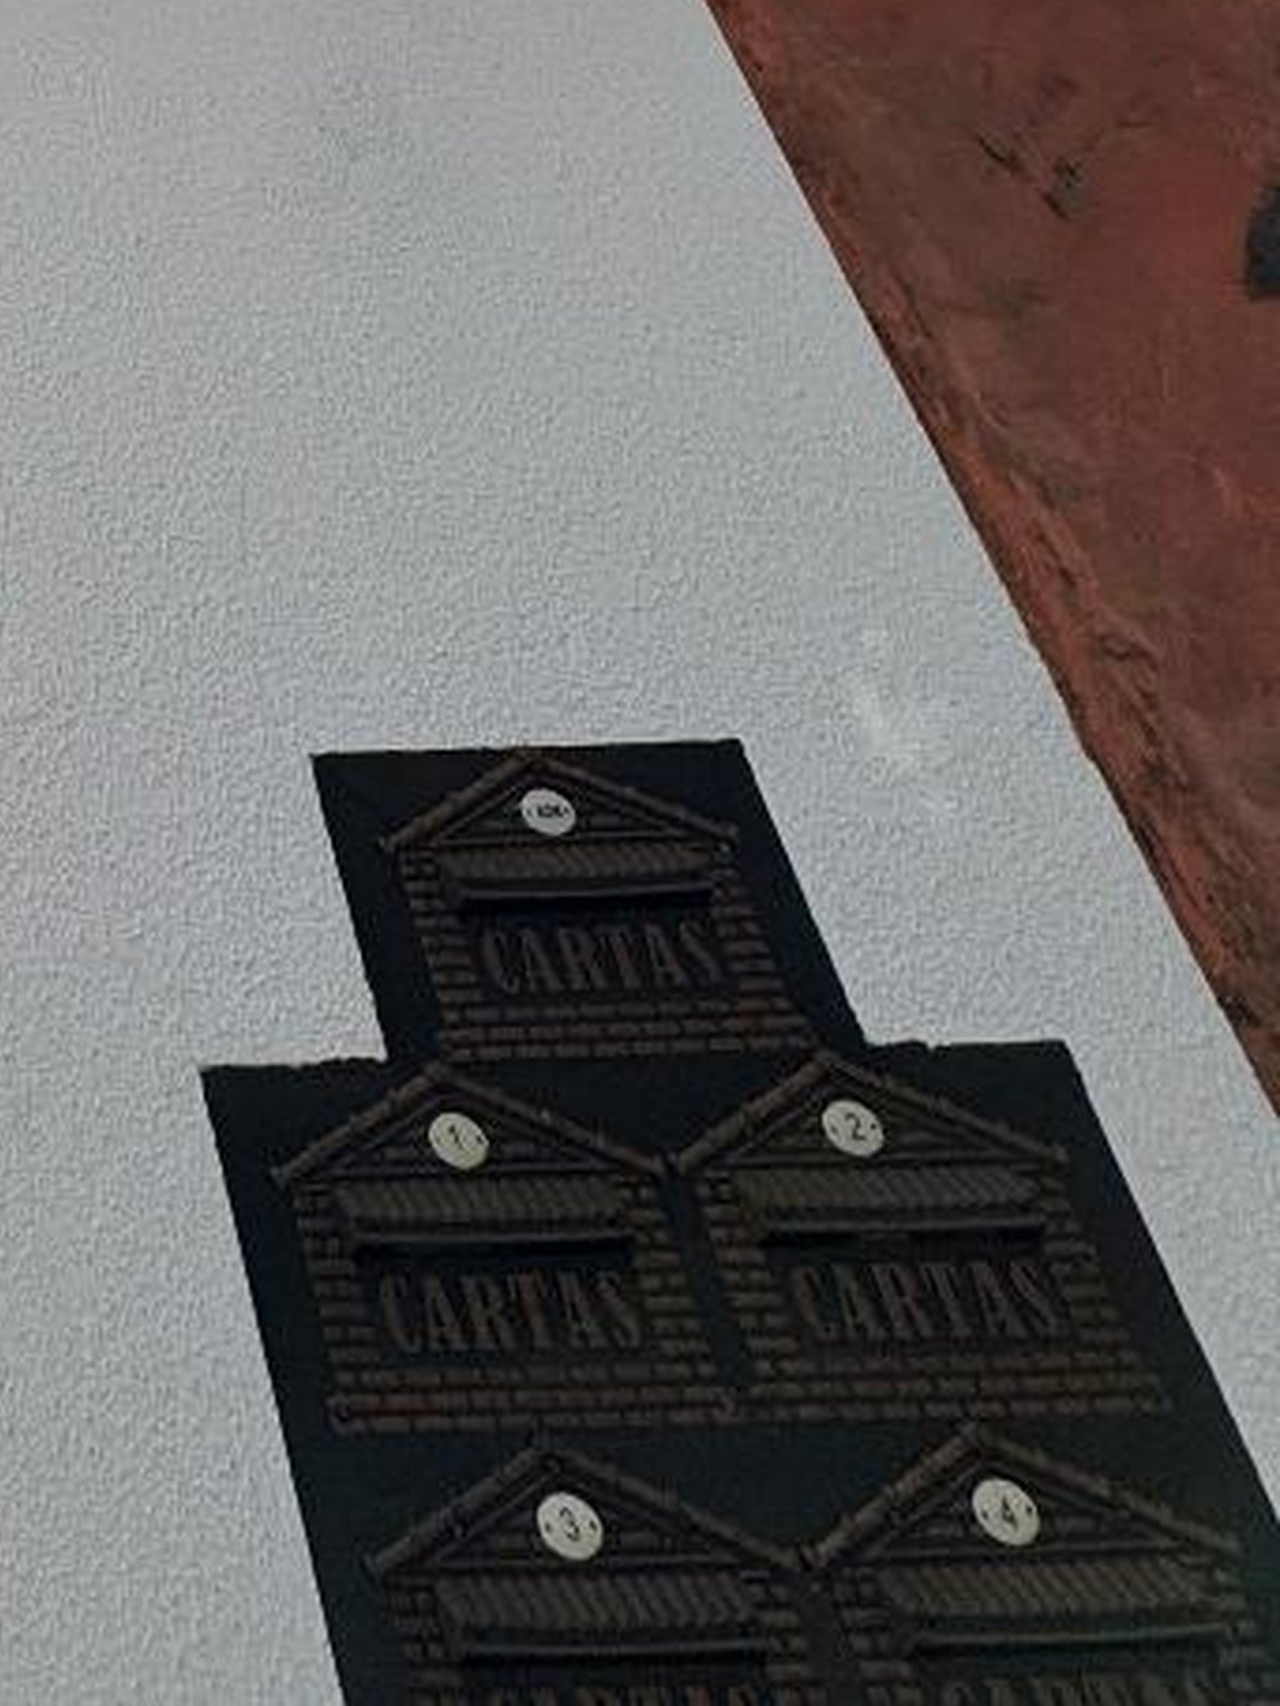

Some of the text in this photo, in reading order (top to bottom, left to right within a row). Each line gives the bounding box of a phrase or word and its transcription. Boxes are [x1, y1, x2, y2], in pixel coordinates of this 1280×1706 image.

[480, 921, 726, 994] CARTAS
[844, 1111, 867, 1141] 2
[378, 1267, 642, 1353] CARTAS
[794, 1261, 1064, 1341] CARTAS
[559, 1507, 581, 1543] 3
